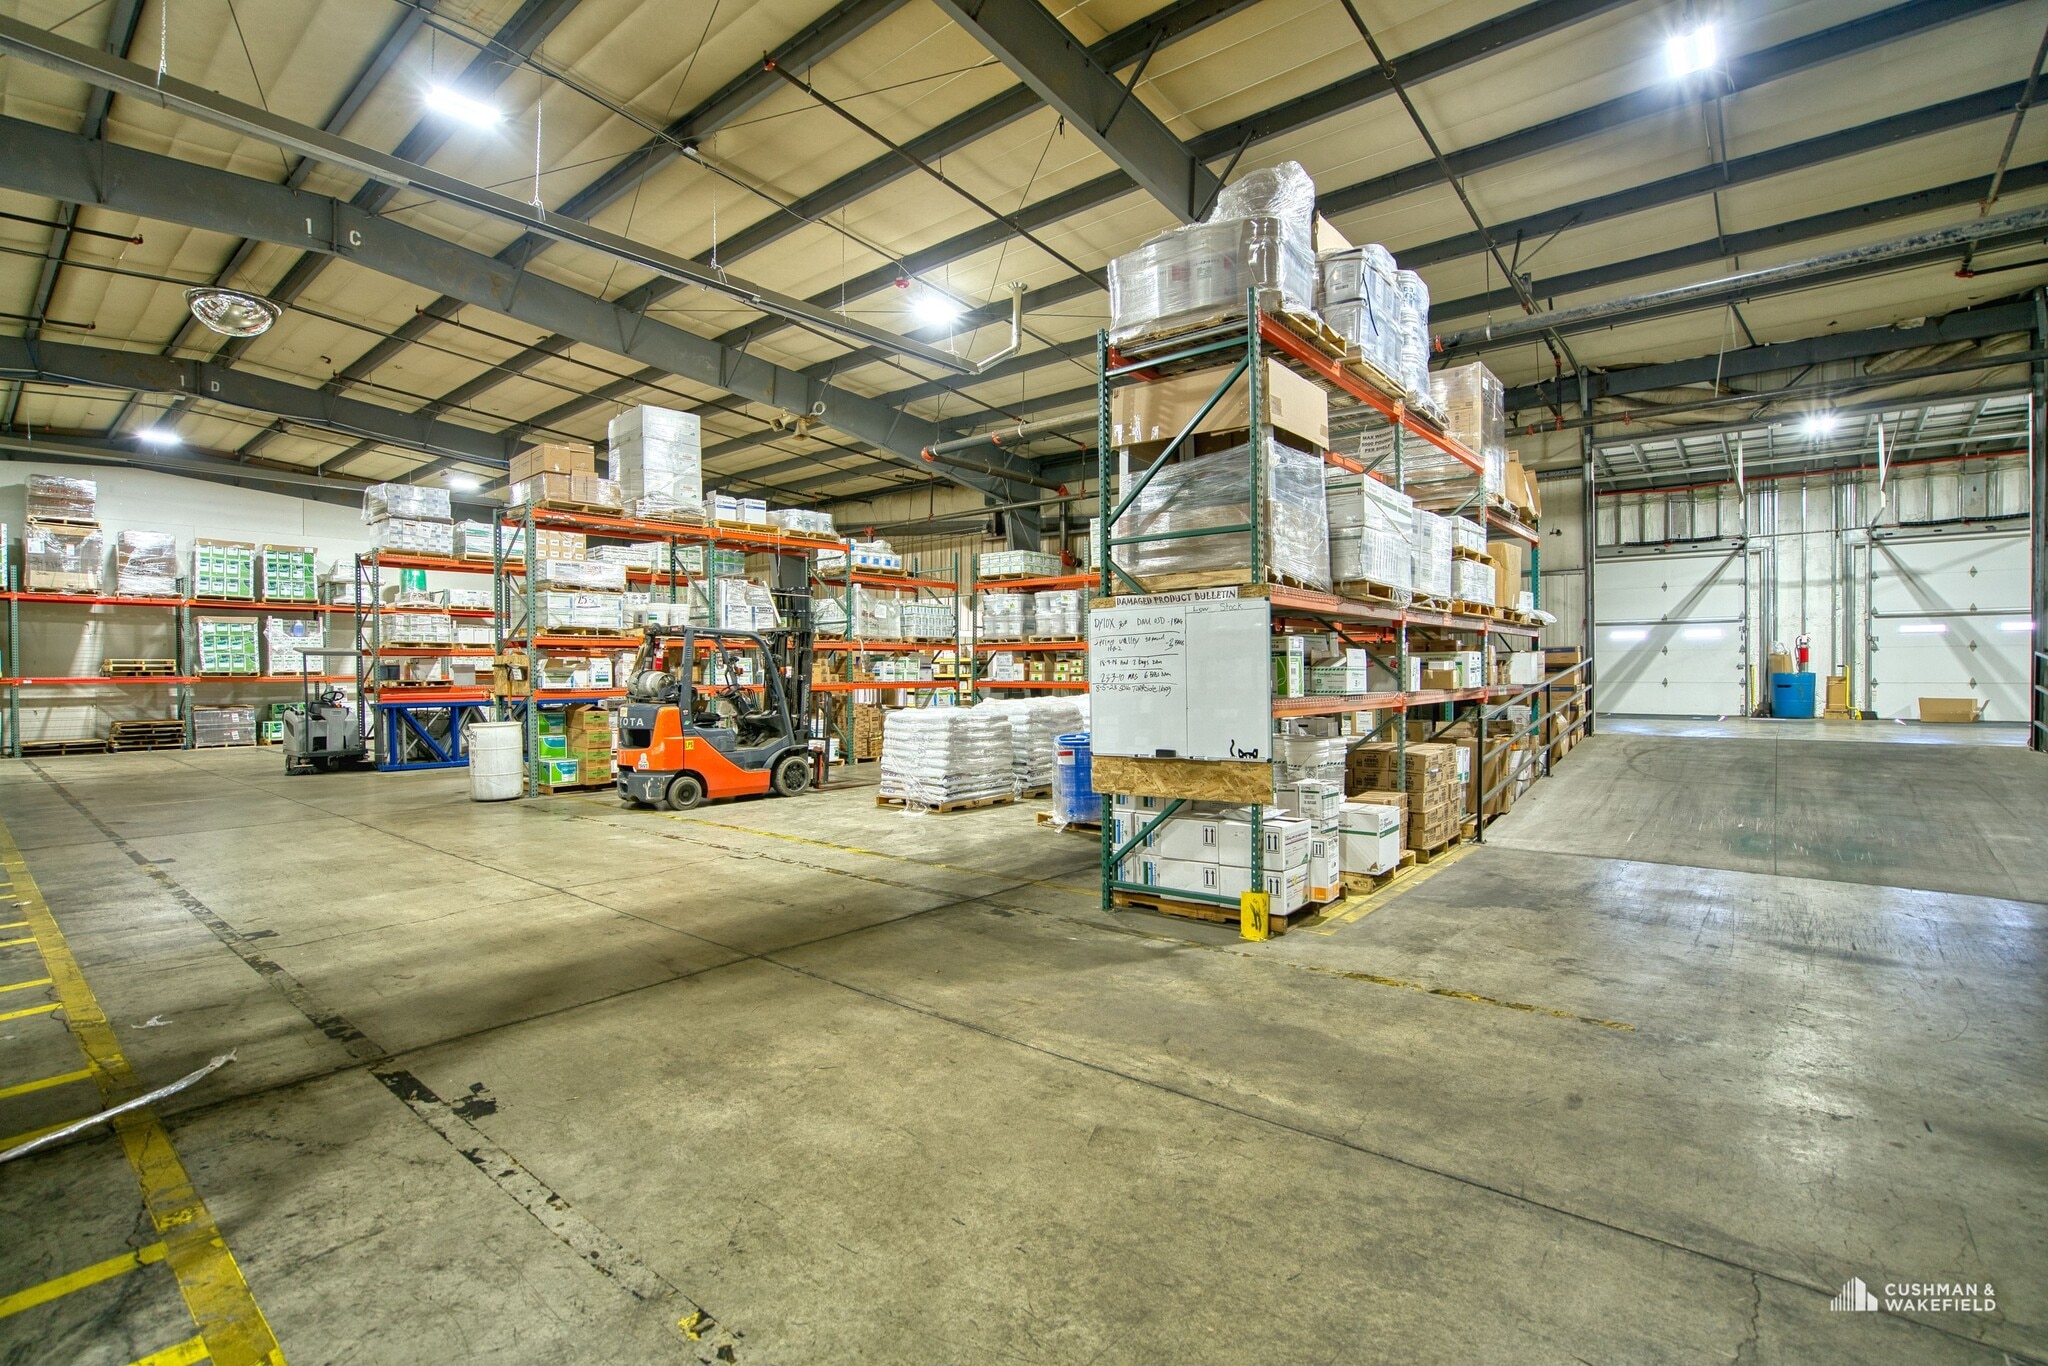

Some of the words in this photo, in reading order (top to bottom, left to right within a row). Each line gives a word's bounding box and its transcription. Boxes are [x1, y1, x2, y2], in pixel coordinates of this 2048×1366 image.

[210, 380, 220, 392] D
[1116, 596, 1153, 607] DAMAGED
[1153, 593, 1192, 605] PRODUCT
[1194, 589, 1236, 600] BULLETIN
[1219, 602, 1244, 611] Stock
